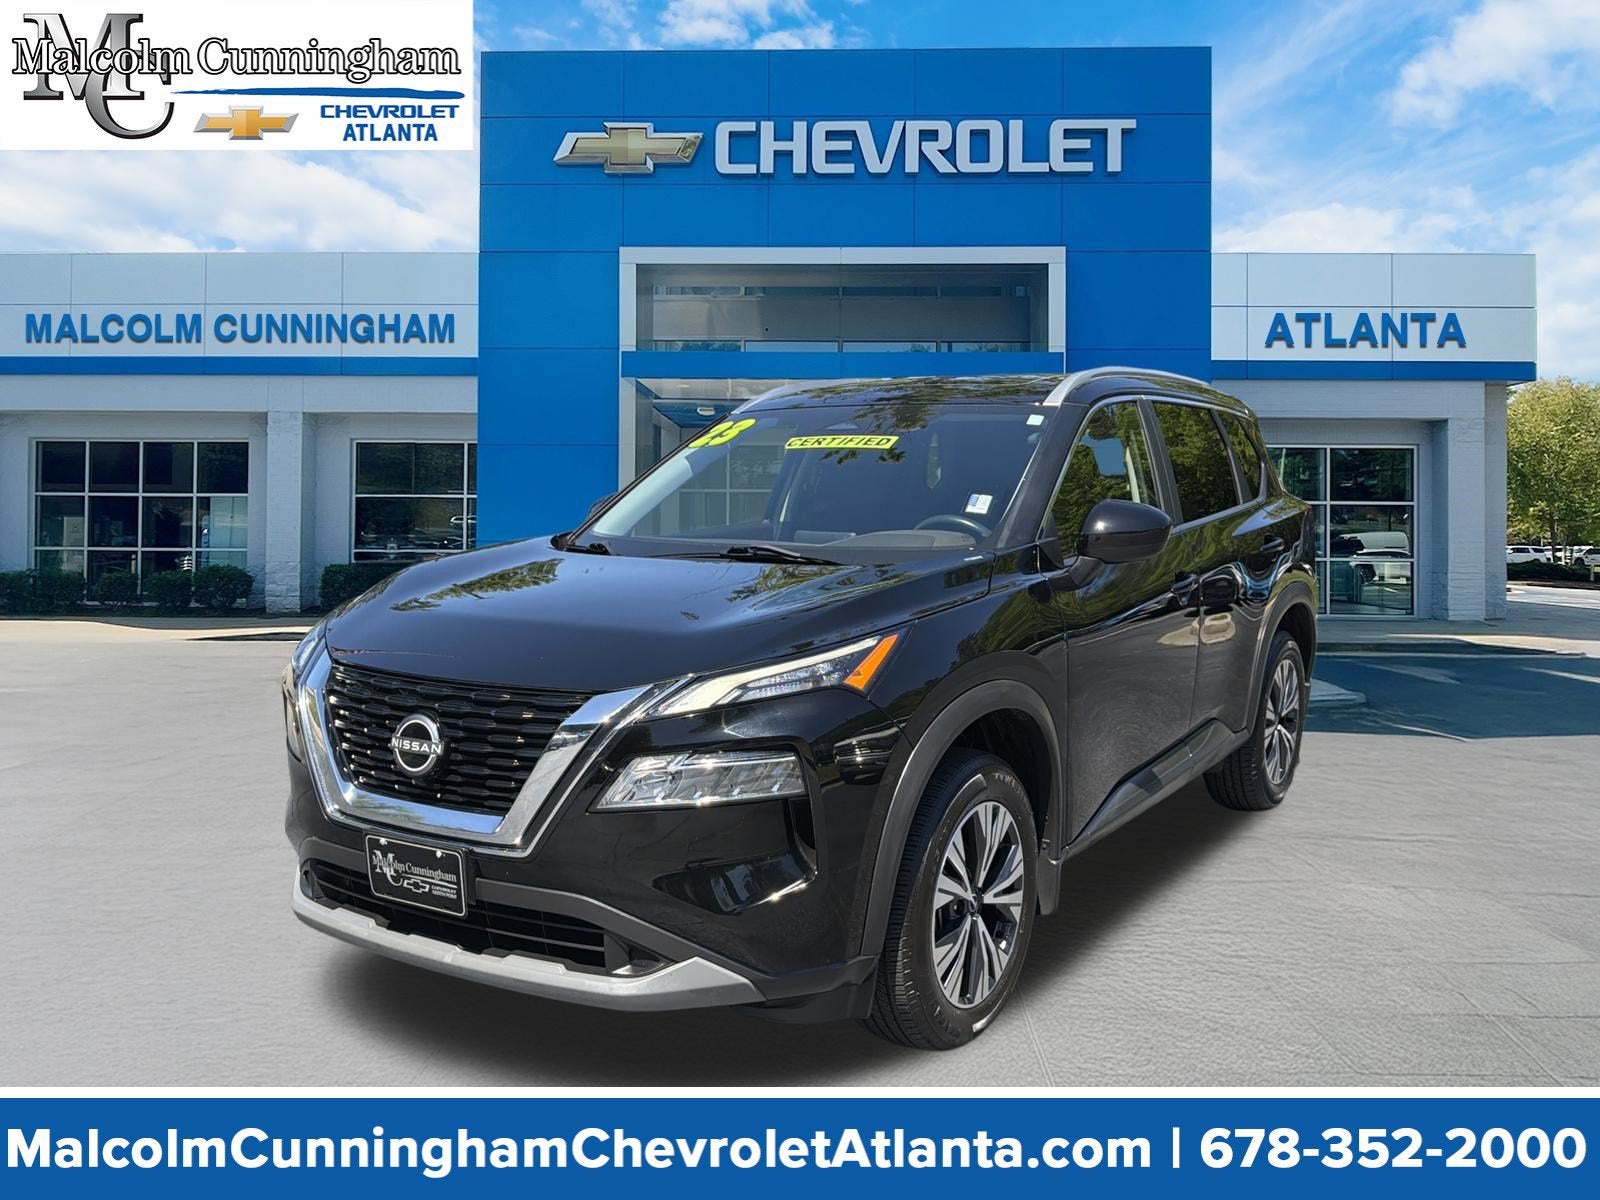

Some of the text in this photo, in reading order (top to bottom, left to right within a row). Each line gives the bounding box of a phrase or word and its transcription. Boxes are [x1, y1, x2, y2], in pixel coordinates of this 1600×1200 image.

[715, 118, 1137, 175] CHEVROLET
[25, 313, 456, 344] MALCOLM CUNNINGHAM
[1264, 312, 1467, 348] ATLANTA
[787, 437, 893, 447] CERTIFIED
[391, 737, 442, 754] NISSAN
[405, 862, 457, 882] Cunningham
